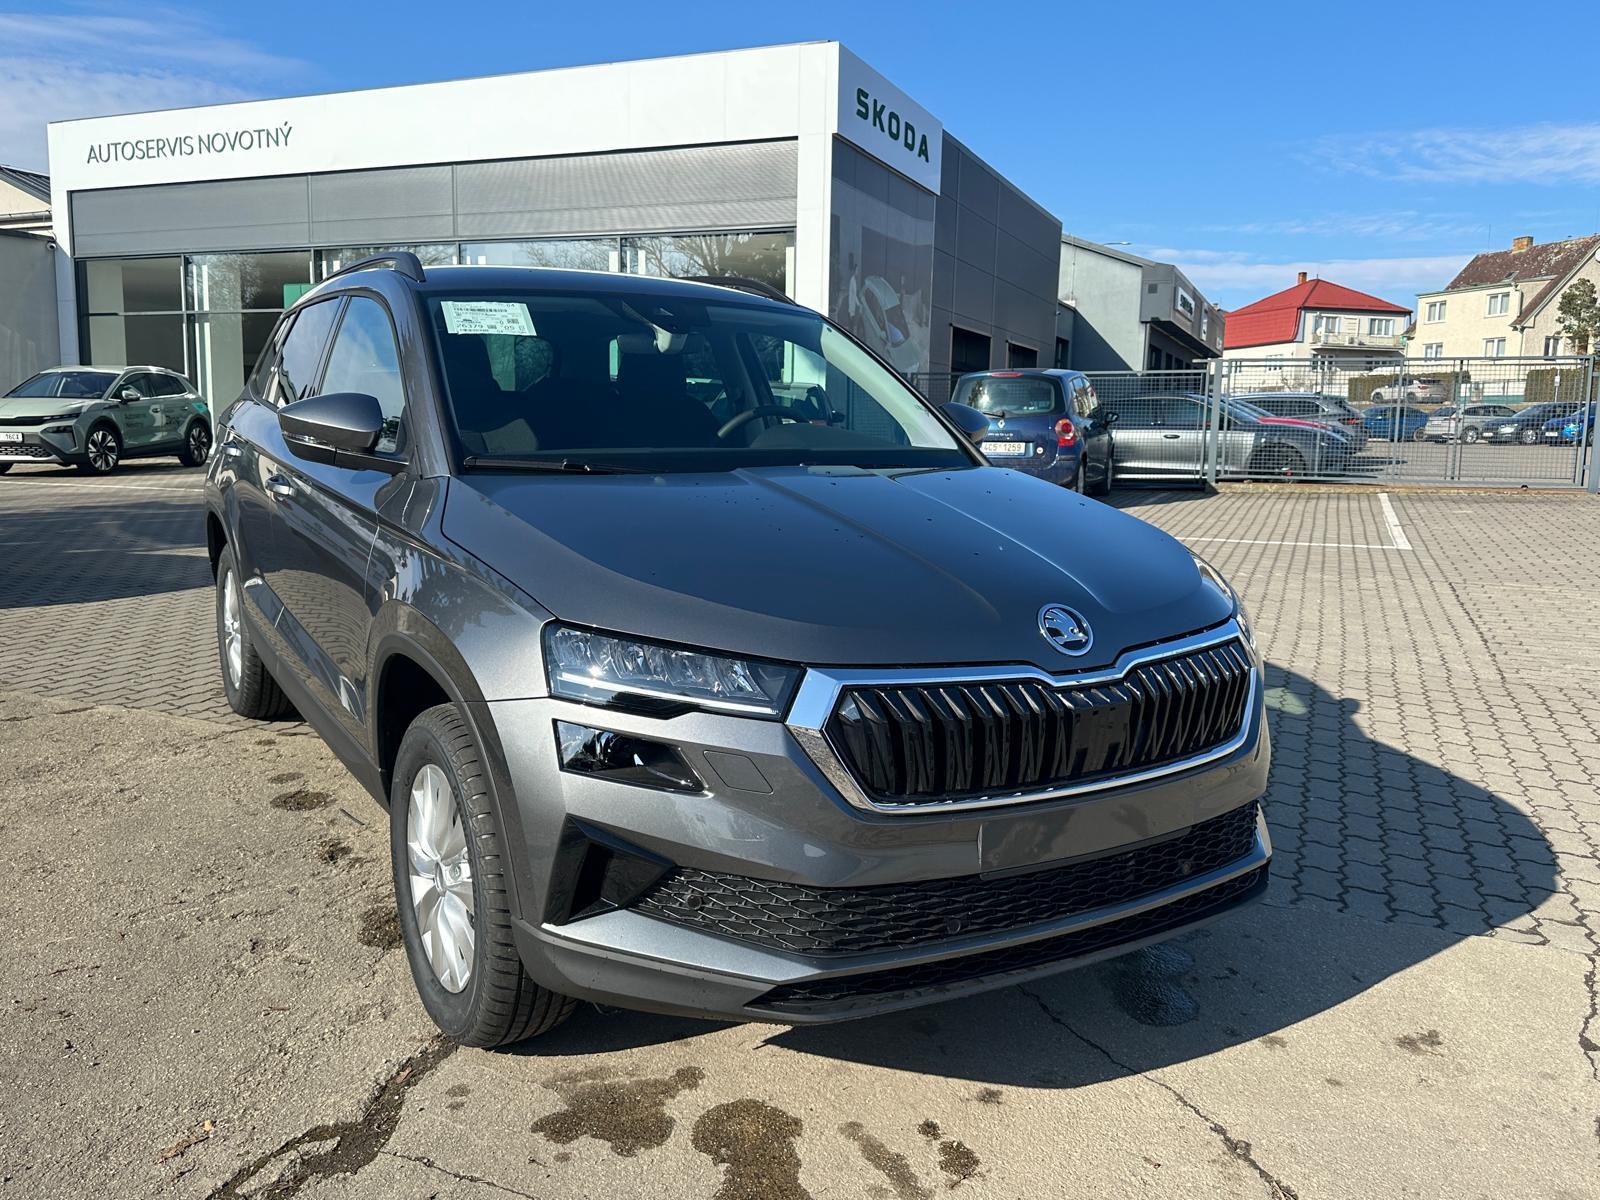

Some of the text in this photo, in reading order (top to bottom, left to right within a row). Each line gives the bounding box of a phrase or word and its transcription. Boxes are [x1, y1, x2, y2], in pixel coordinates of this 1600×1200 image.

[86, 121, 293, 164] AUTOSERVIS NOVOTNÝ
[856, 87, 930, 163] SKODA
[1003, 443, 1022, 452] 1259
